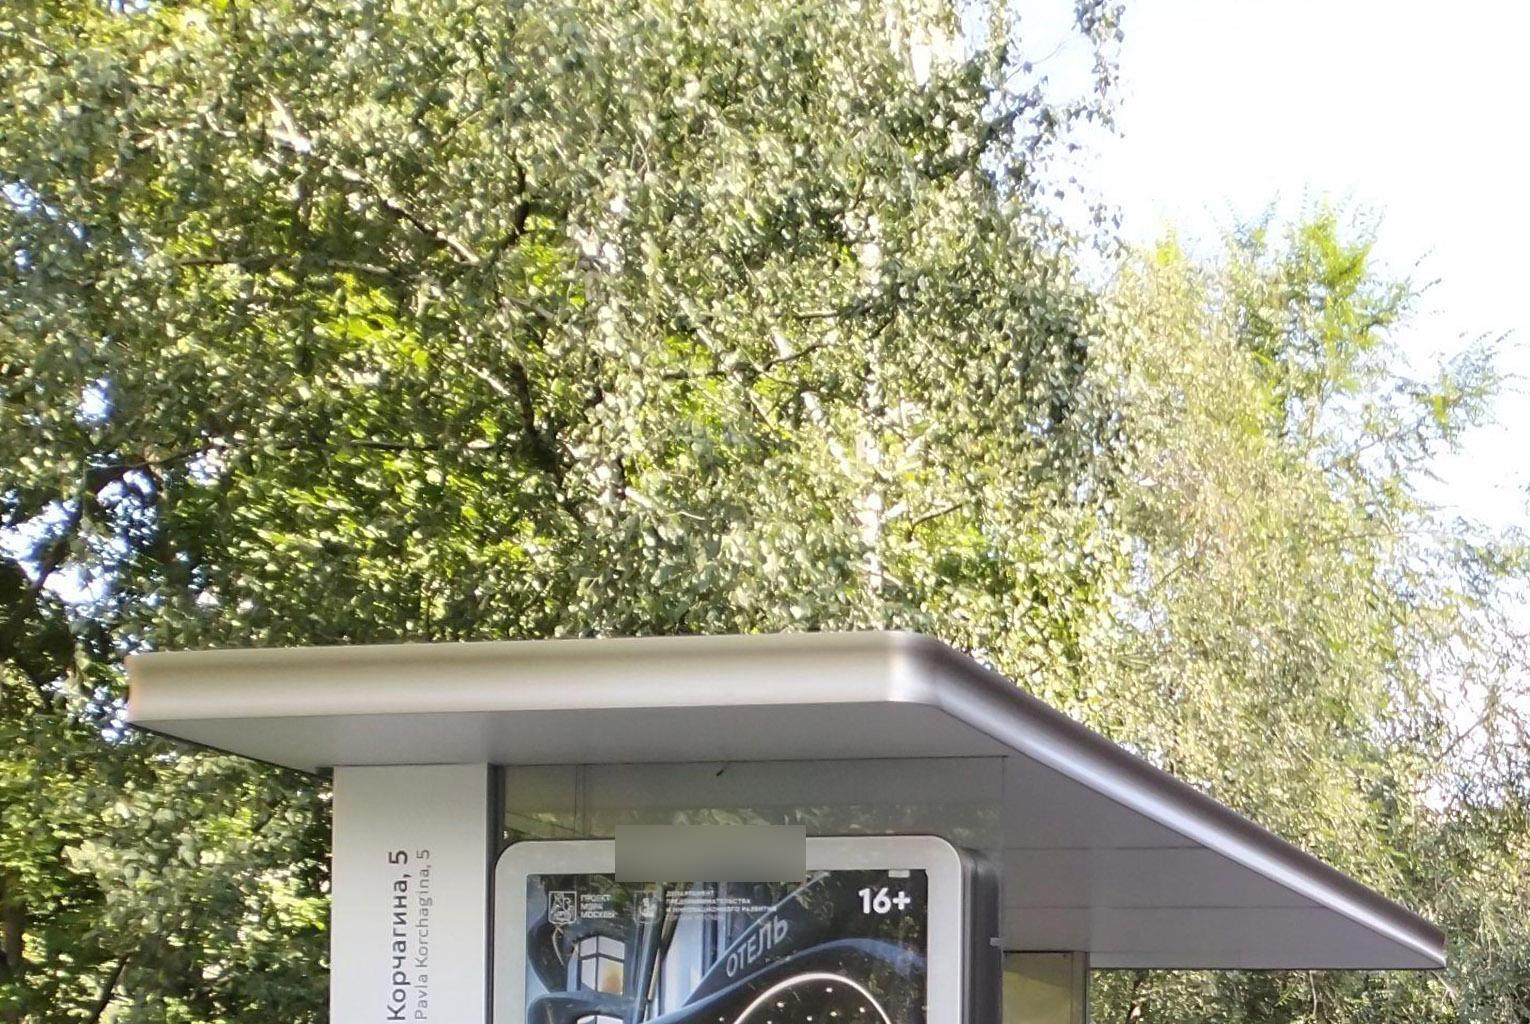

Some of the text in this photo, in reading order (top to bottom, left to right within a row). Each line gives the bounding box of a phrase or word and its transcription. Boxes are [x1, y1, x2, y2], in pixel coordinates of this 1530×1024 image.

[388, 850, 408, 865] 5
[416, 849, 430, 860] 5
[415, 864, 432, 968] Korchagina,
[857, 887, 911, 914] 16+
[386, 873, 411, 1021] Корчагина,
[726, 915, 789, 978] ОТЕЛЬ
[414, 973, 428, 1020] Pavla
